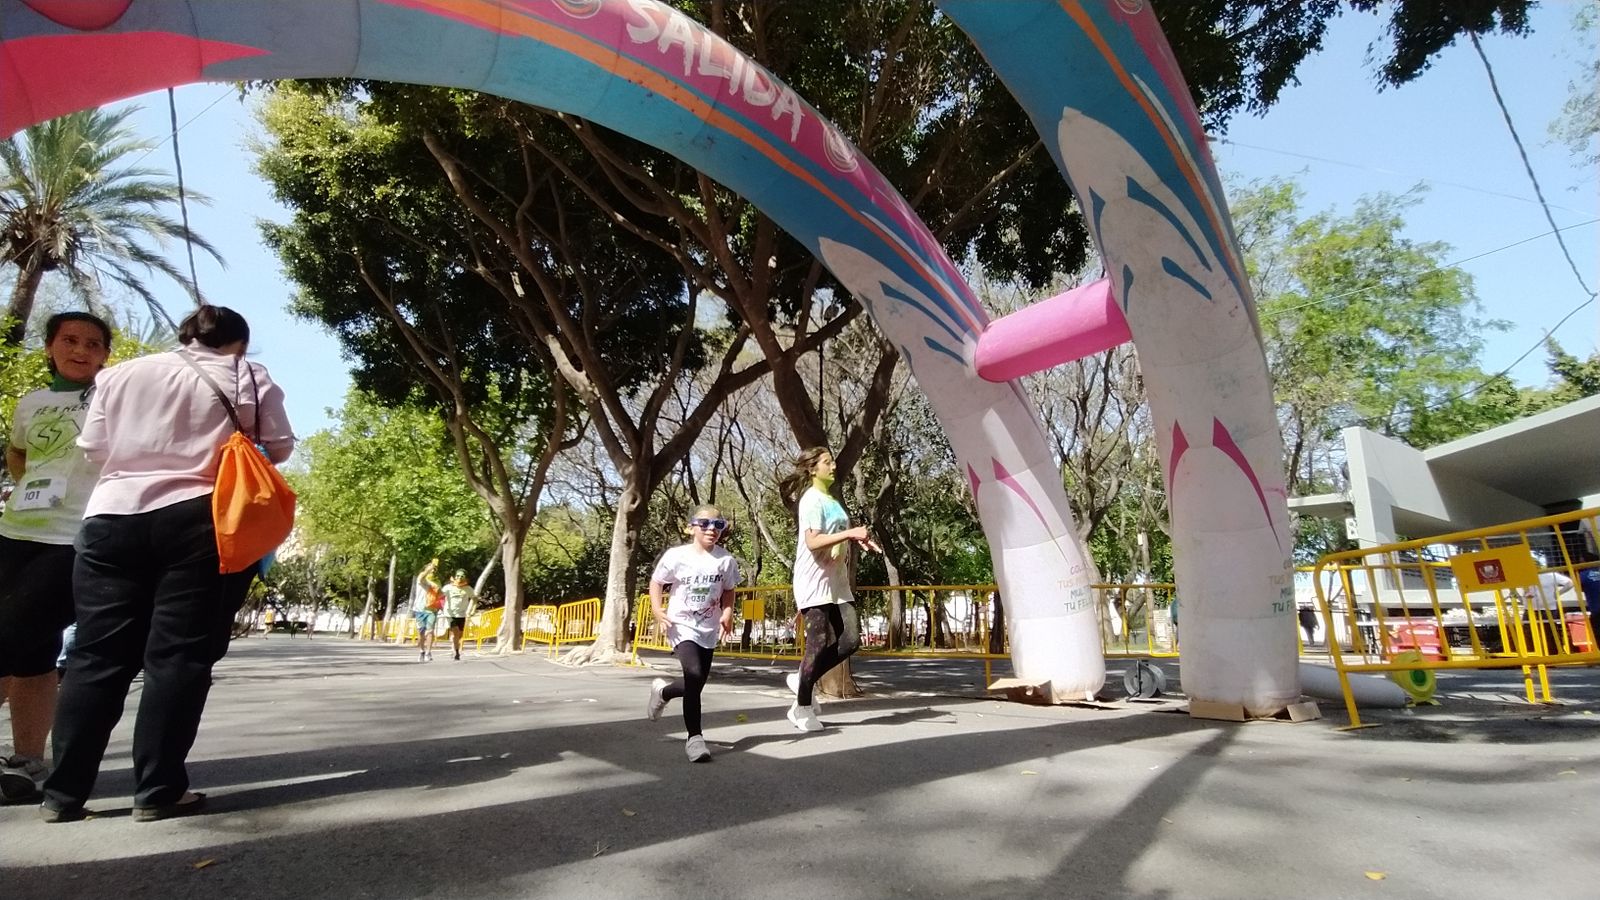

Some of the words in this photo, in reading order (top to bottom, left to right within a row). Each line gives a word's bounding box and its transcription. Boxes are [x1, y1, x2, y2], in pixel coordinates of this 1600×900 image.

[626, 0, 805, 143] SALIDA
[24, 490, 40, 502] 101
[693, 575, 700, 584] A
[691, 595, 706, 603] 038
[1064, 601, 1076, 613] TU
[1271, 602, 1284, 614] TU
